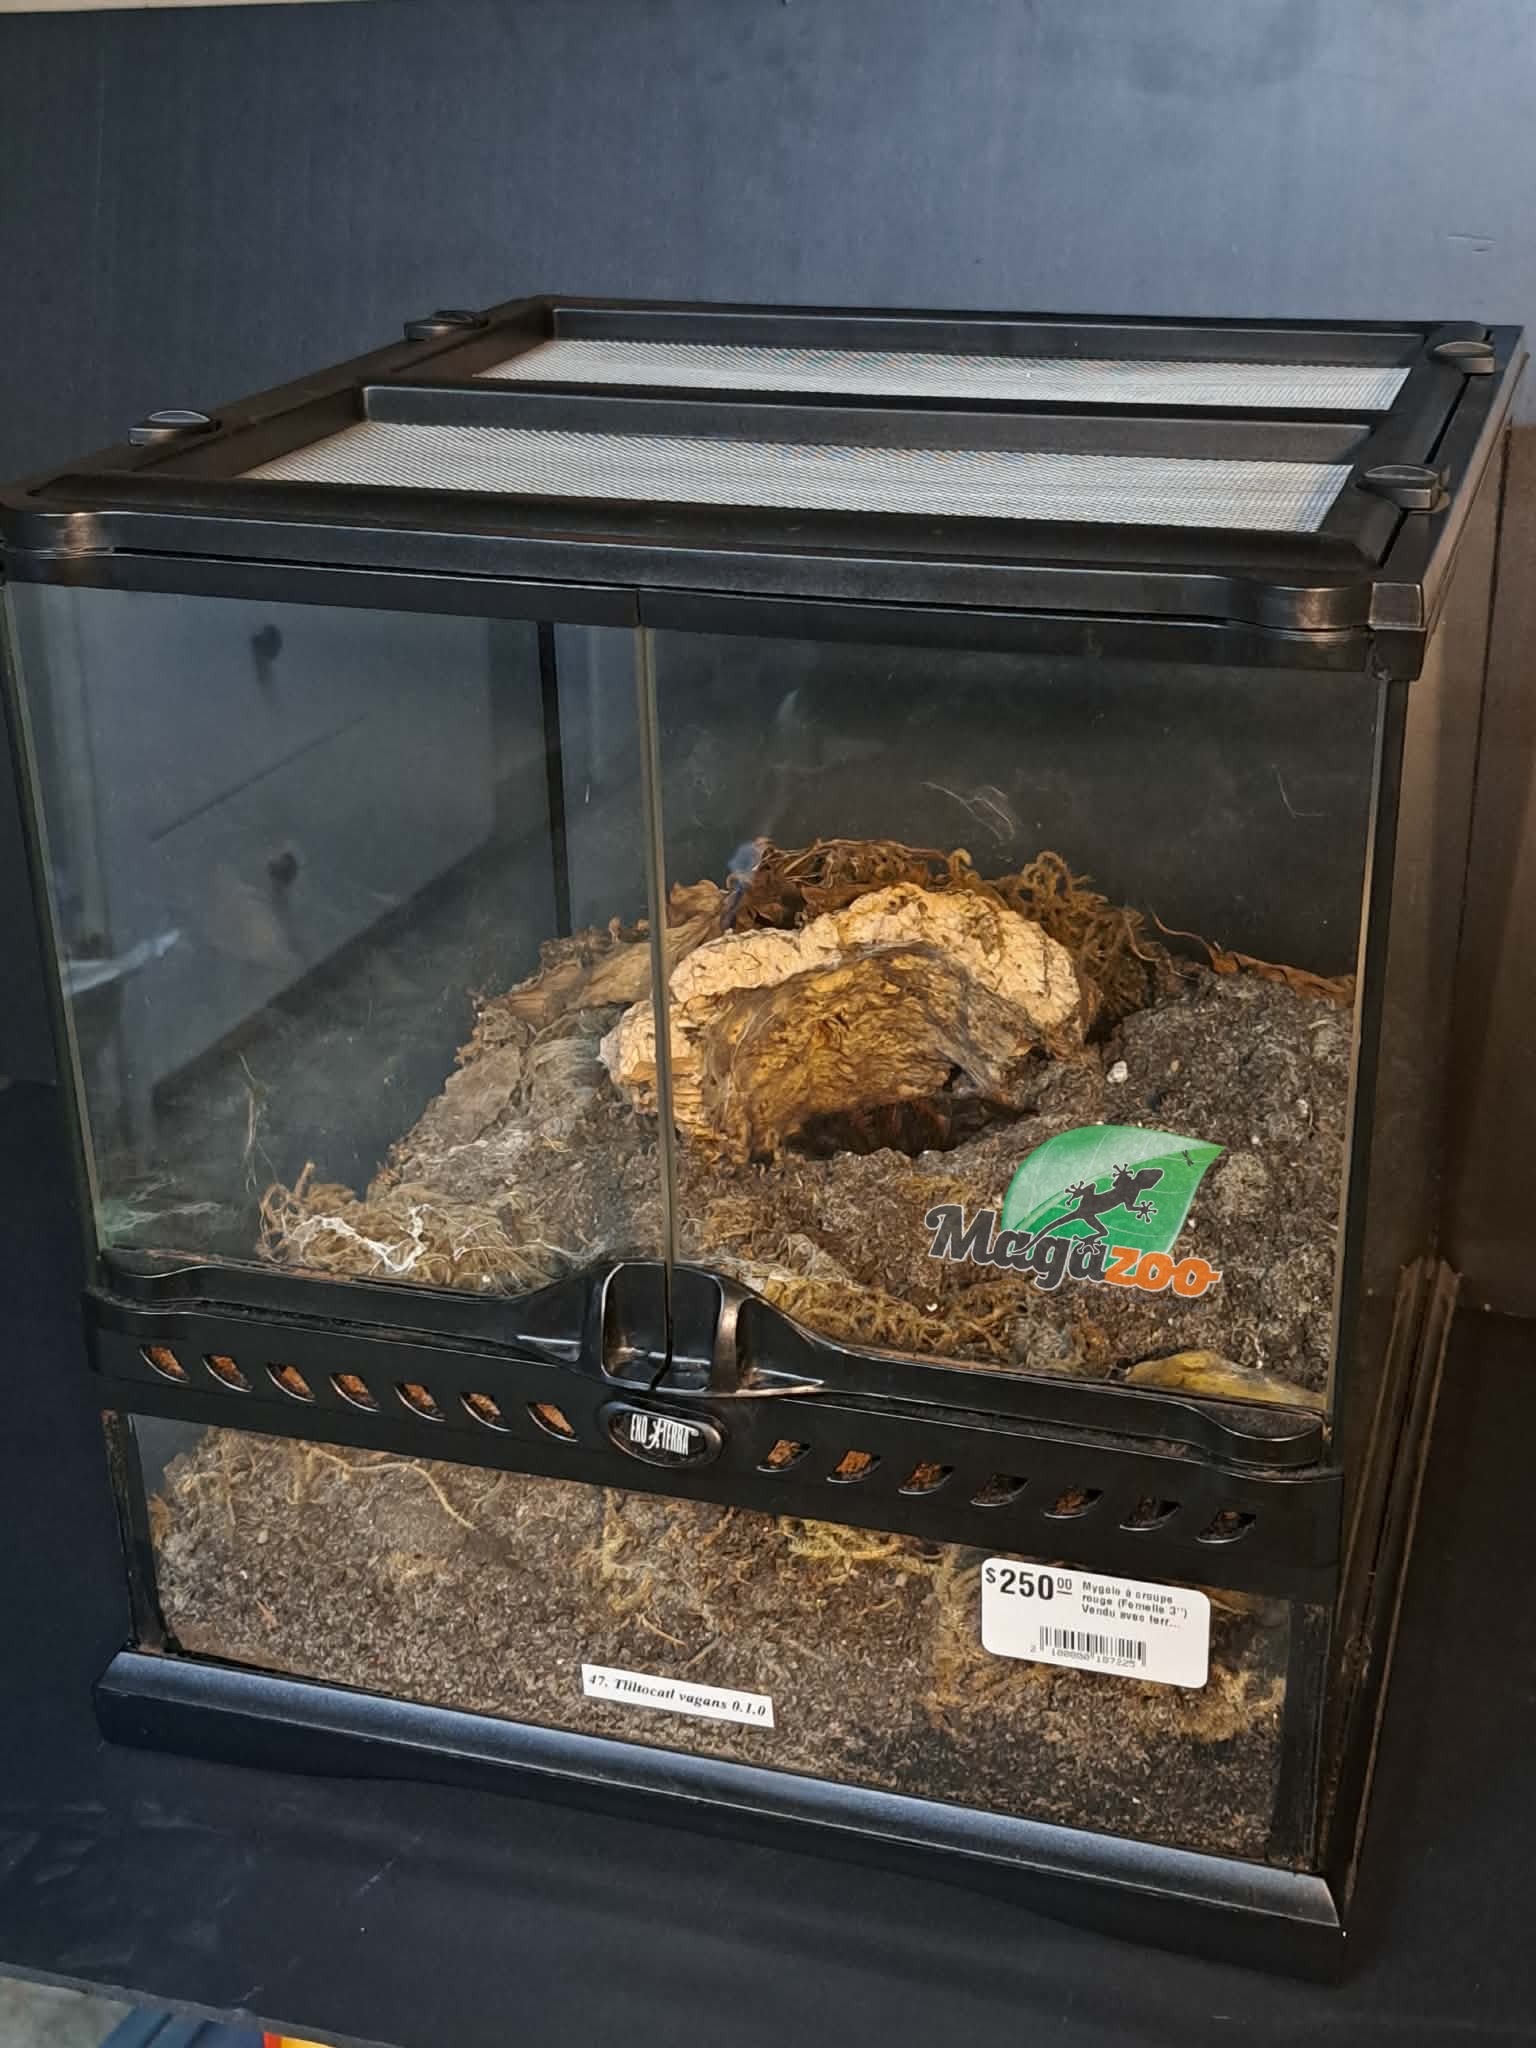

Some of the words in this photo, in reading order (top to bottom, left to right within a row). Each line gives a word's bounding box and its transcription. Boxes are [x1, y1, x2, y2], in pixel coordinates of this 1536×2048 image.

[1082, 1594, 1113, 1606] rouge
[1081, 1603, 1116, 1617] Vendu
[1120, 1611, 1145, 1622] avec
[589, 1674, 608, 1688] 47.
[679, 1693, 727, 1709] vagans
[732, 1700, 766, 1716] 0.1.0
